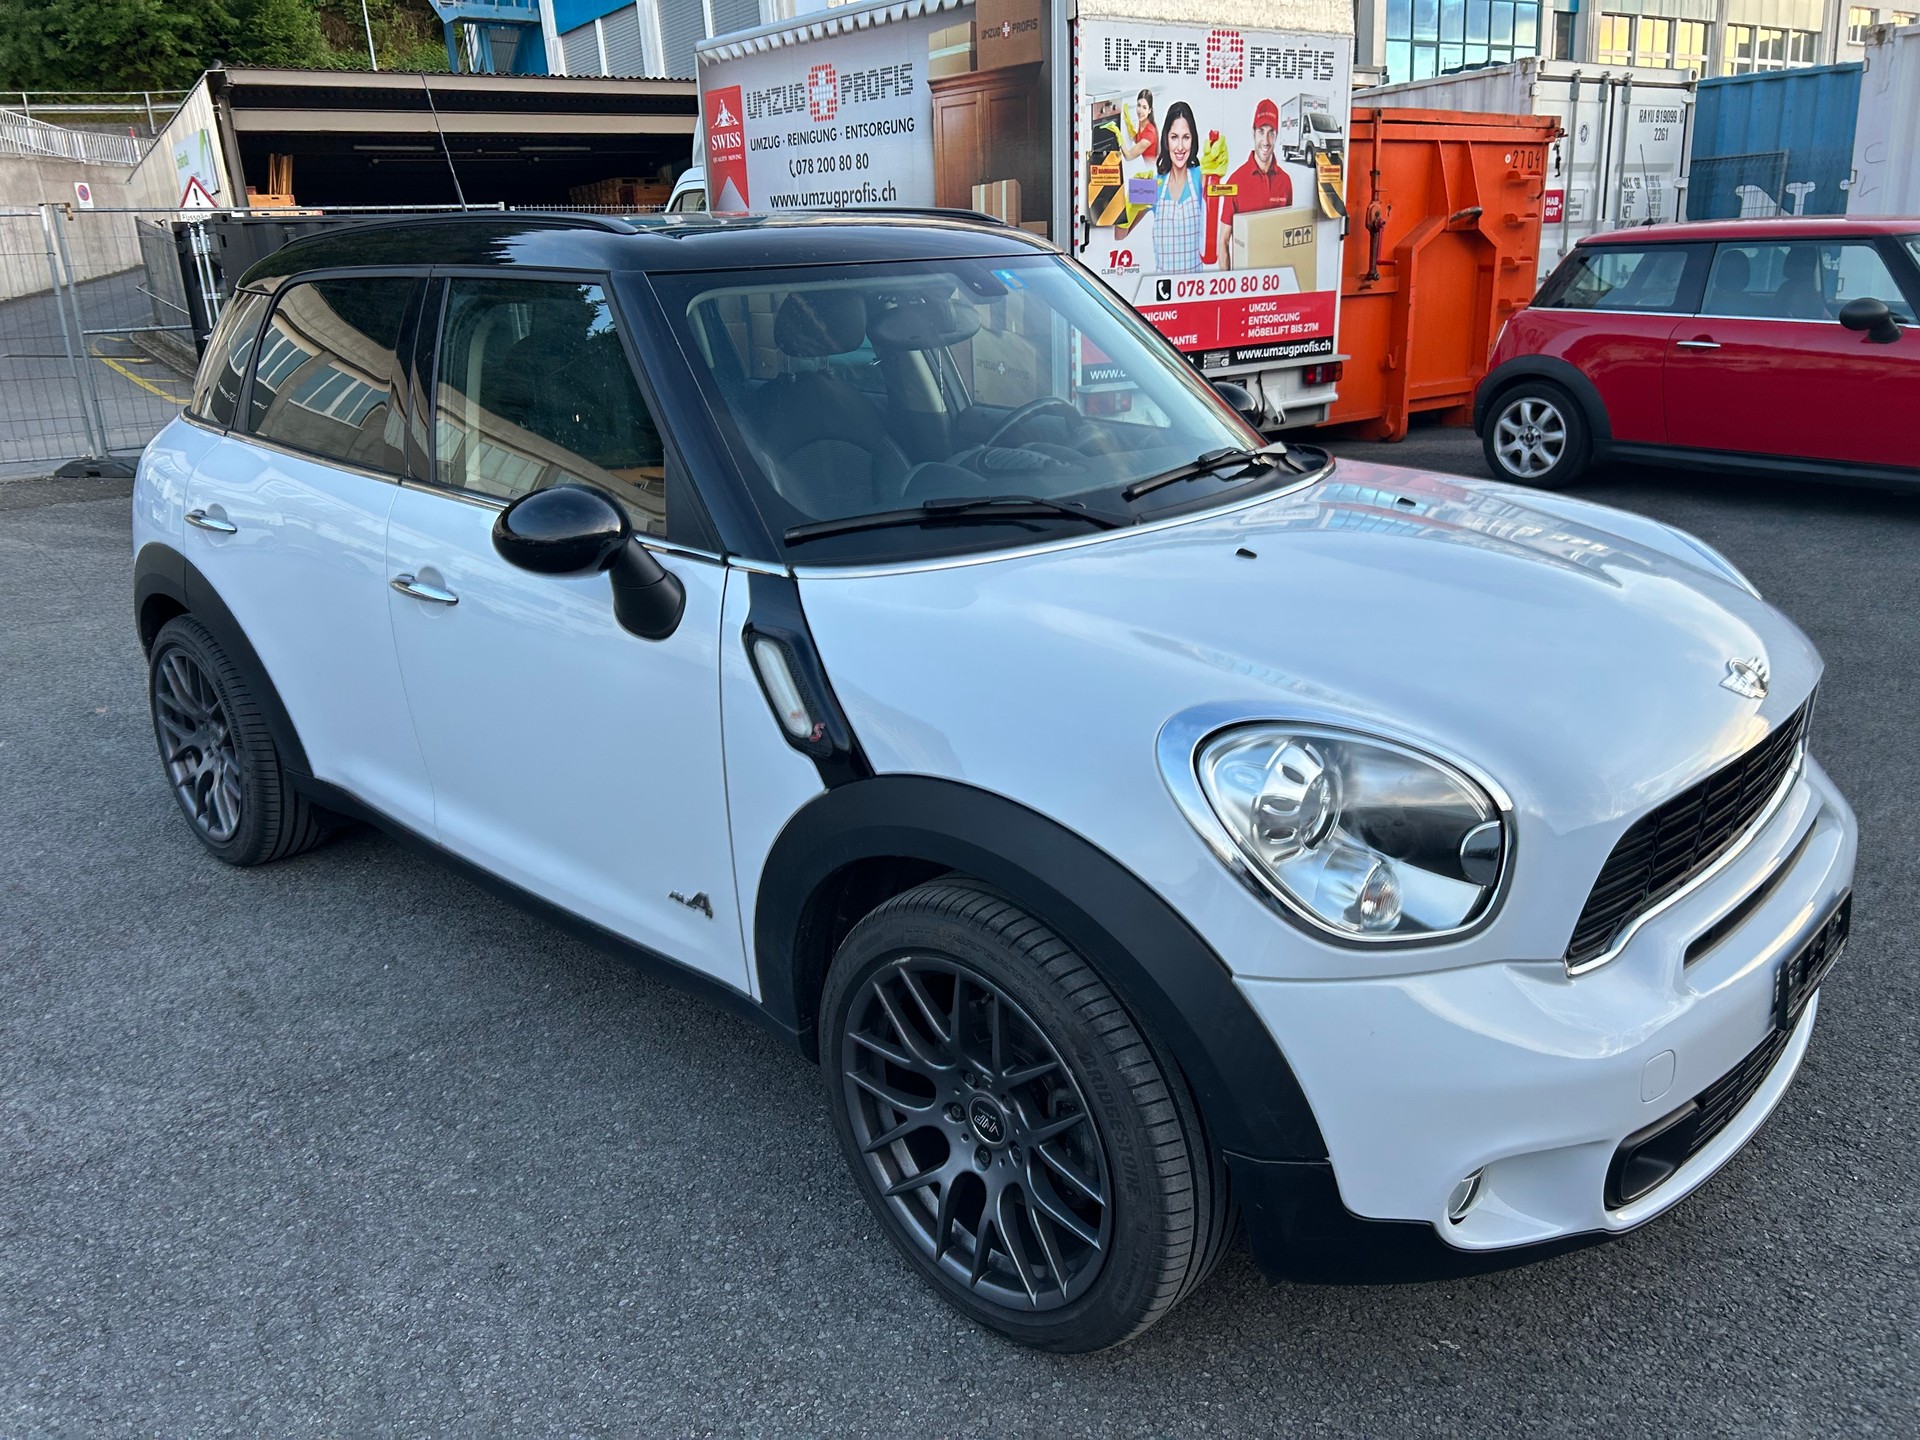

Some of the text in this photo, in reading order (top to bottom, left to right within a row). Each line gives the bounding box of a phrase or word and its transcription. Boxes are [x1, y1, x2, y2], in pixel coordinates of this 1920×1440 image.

[981, 19, 1038, 39] UMZUG PROFIS
[1104, 37, 1335, 81] UMZUG PROFIS
[746, 63, 914, 119] UMZUG PROFIS
[711, 132, 741, 151] SWISS
[750, 117, 915, 151] UMZUG REINIGUNG ENTSORGUNG
[796, 153, 869, 175] 078 200 80 80
[1512, 151, 1541, 169] 2704
[770, 180, 897, 208] www.umzugprofis.ch
[1546, 196, 1559, 206] HAB
[1545, 207, 1559, 217] GUT
[1177, 274, 1279, 298] 078 200 80 80
[1141, 311, 1177, 322] NIGUNG
[1249, 302, 1277, 313] UMZUG
[1248, 312, 1300, 326] ENTSORGUNG
[1247, 322, 1319, 338] MÖBELLIFT BIS 27M
[1236, 339, 1331, 360] www.umzugprofis.ch
